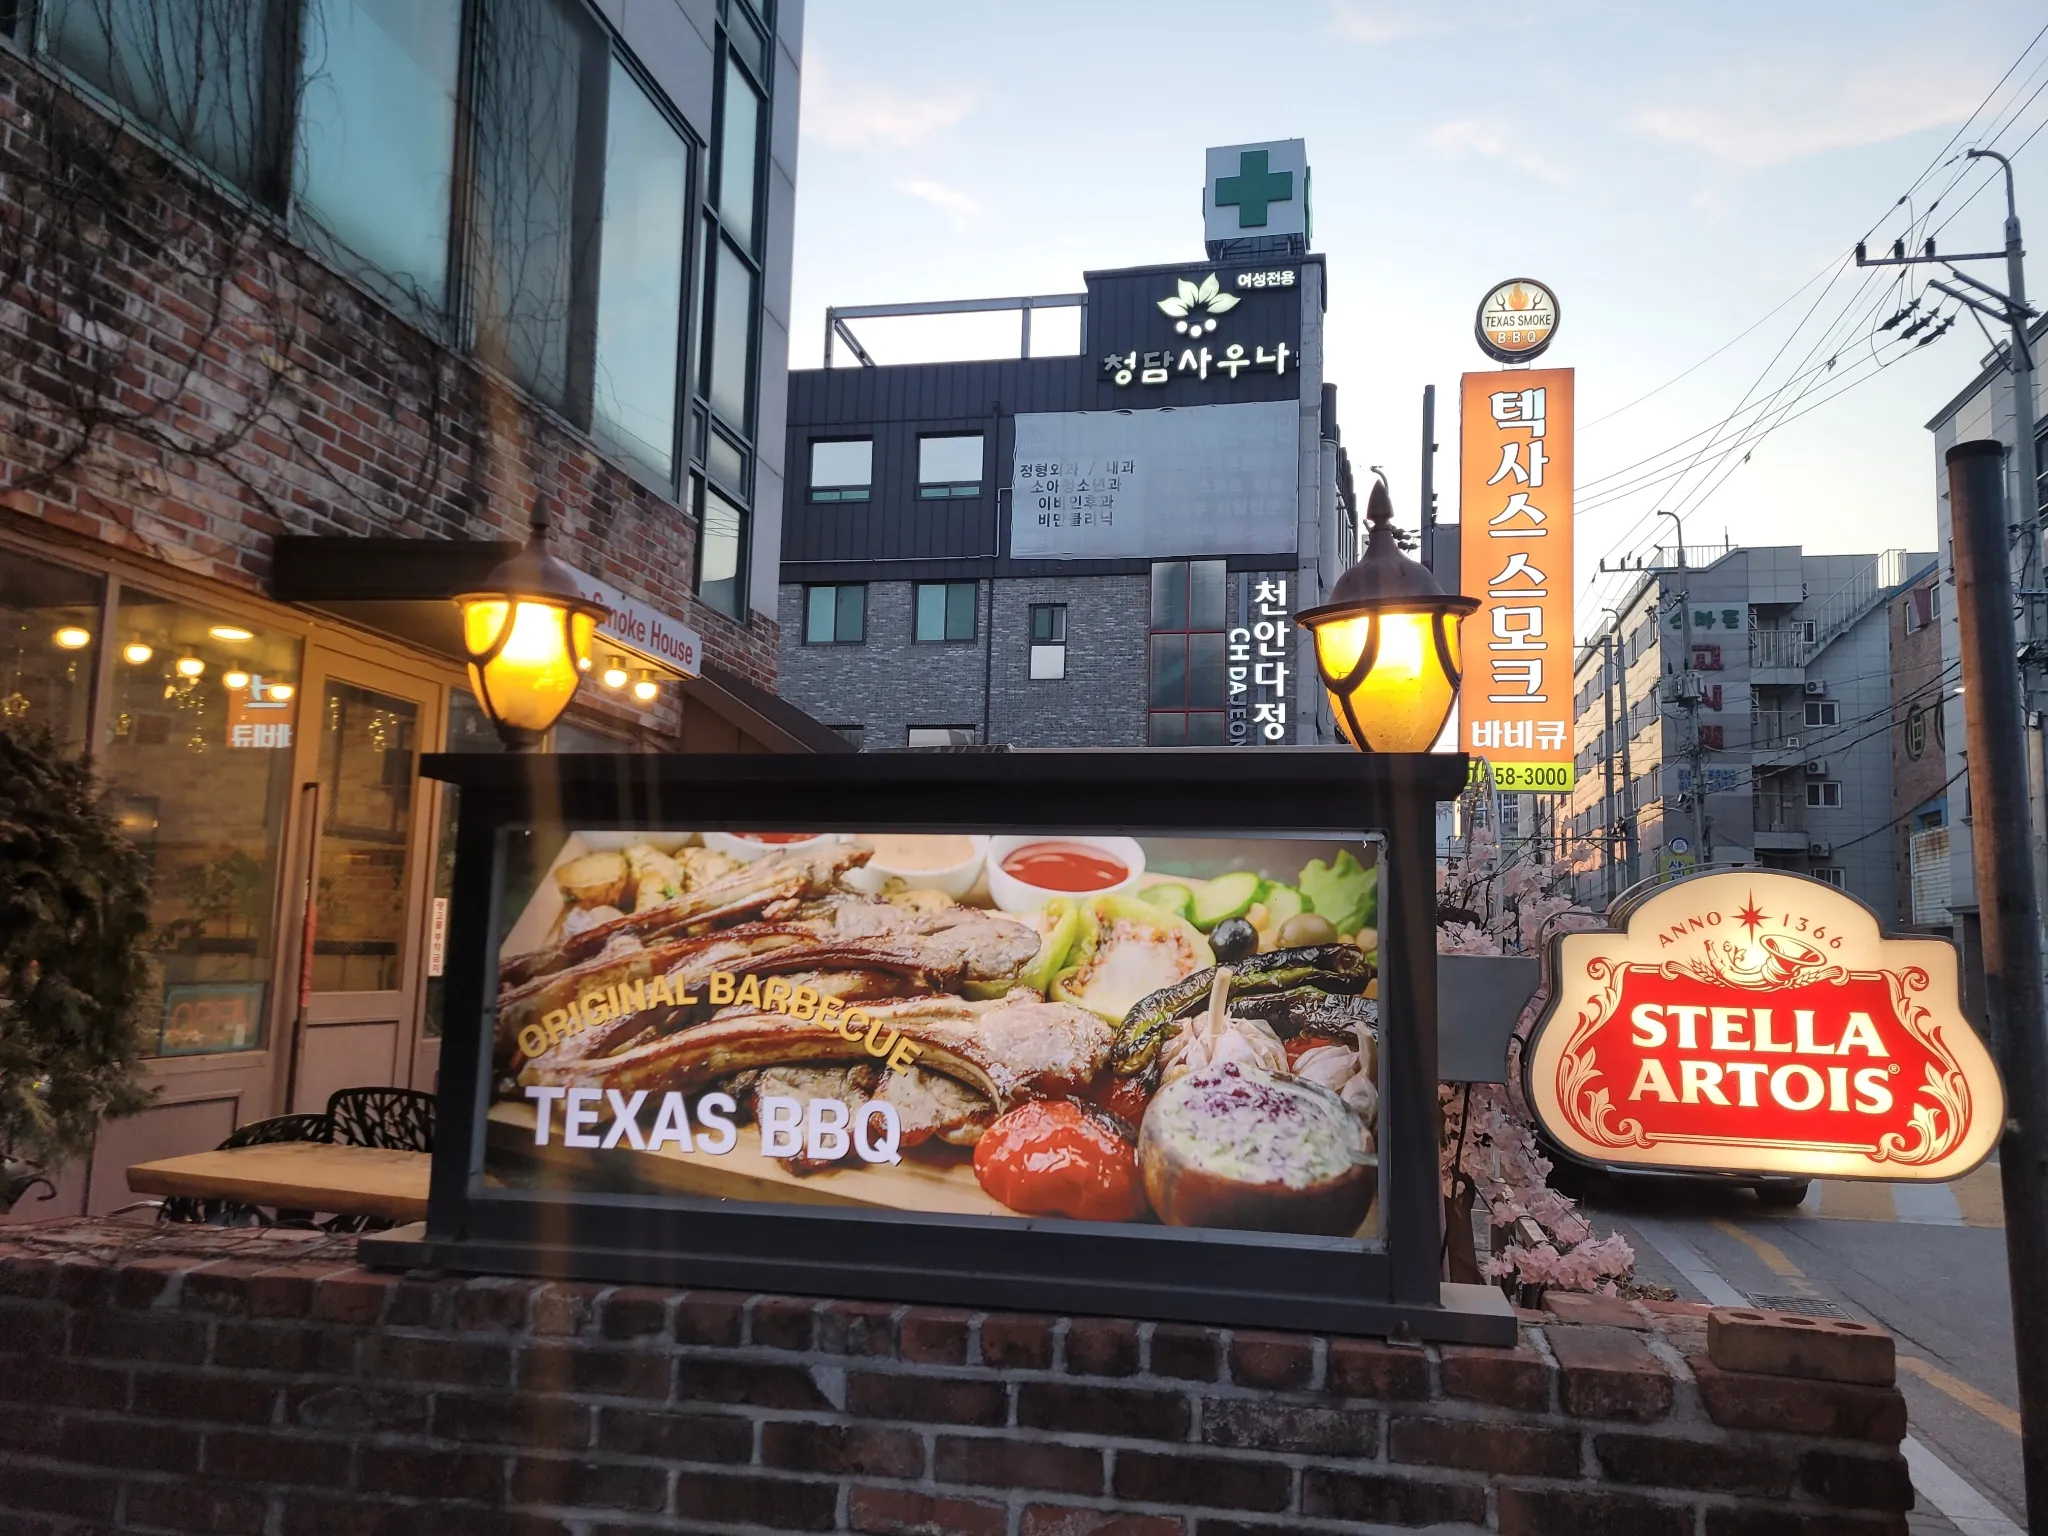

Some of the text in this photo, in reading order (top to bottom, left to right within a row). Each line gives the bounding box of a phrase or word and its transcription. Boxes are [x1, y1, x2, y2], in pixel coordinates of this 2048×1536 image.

[1237, 270, 1296, 288] 여성전용
[1485, 313, 1552, 329] TEXAS SMOKE
[1103, 342, 1290, 386] 청담사우나
[1020, 461, 1080, 479] 정형외과
[1106, 459, 1136, 475] 내과
[1038, 494, 1114, 511] 이비인후과
[1038, 510, 1114, 528] 비만클리닉
[650, 619, 693, 666] House
[1253, 576, 1291, 740] 천안다정
[1471, 719, 1568, 751] 바비큐
[1658, 911, 1844, 949] ANNO 1366
[517, 971, 924, 1076] ORIGINAL BARBECUE
[1630, 1003, 1890, 1057] STELLA
[525, 1085, 904, 1167] TEXAS BBQ
